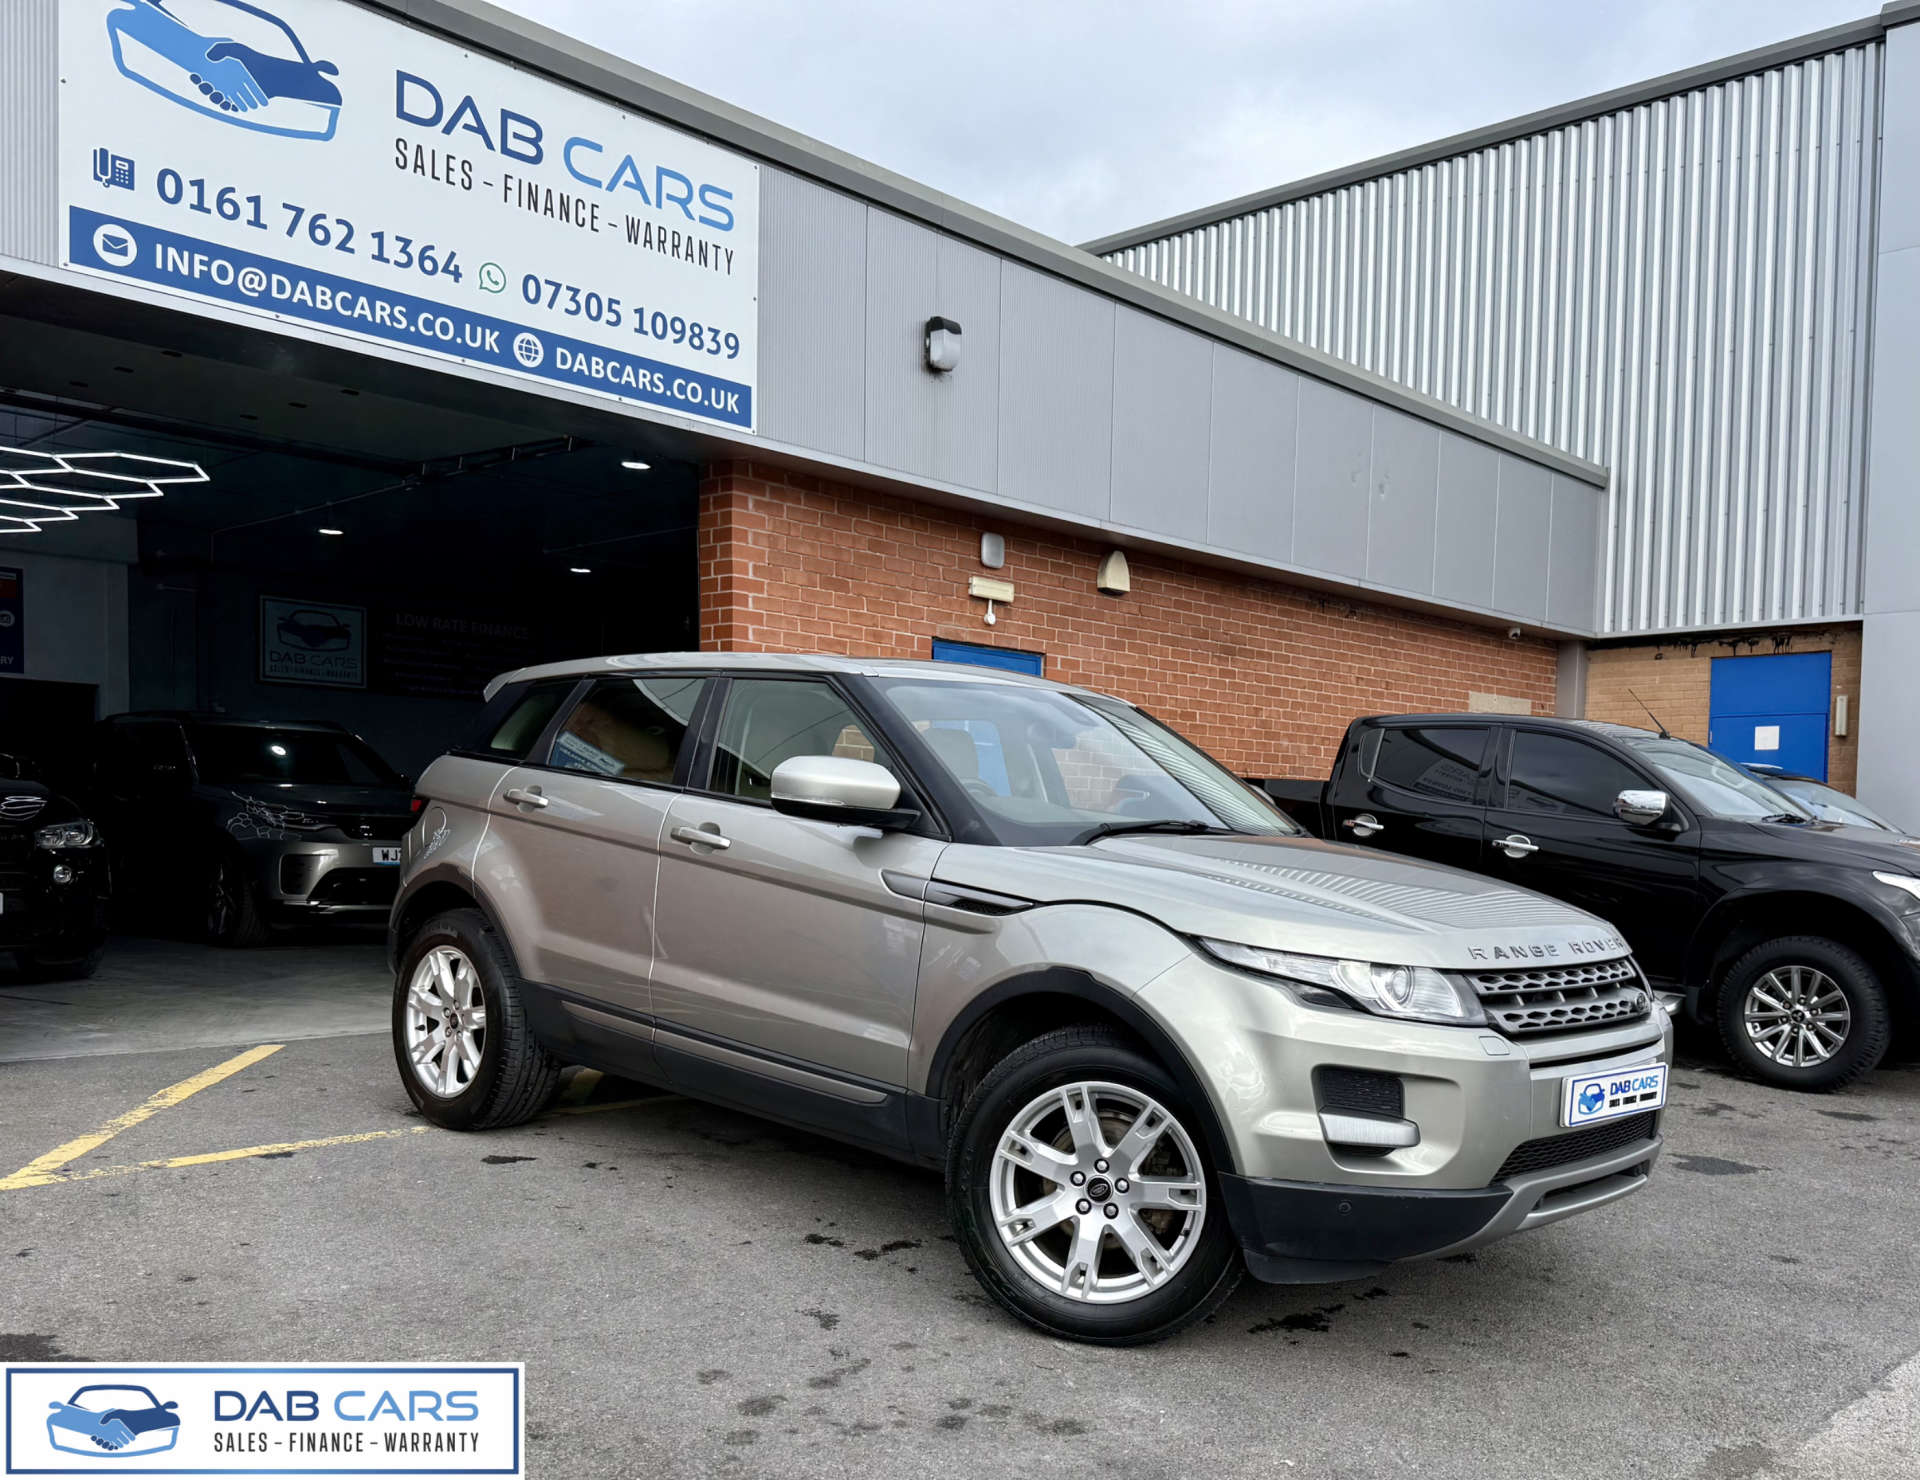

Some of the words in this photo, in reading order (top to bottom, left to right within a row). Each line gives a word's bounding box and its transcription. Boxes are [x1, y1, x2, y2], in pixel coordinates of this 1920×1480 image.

[396, 69, 544, 165] DAB
[563, 136, 735, 232] CARS
[156, 168, 268, 230] 0161
[281, 202, 355, 254] 762
[371, 231, 463, 283] 1364
[395, 137, 473, 190] SALES
[504, 173, 600, 232] FINANCE
[625, 214, 734, 275] WARRANTY
[155, 243, 501, 353] INFO@DABCARS.CO.UK
[522, 274, 622, 327] 07305
[633, 307, 740, 360] 109839
[556, 347, 740, 414] DABCARS.CO.UK
[269, 650, 306, 664] DAB
[381, 848, 402, 861] WJ
[1467, 943, 1560, 960] RANGE
[1567, 937, 1625, 954] ROVER
[1610, 1080, 1631, 1095] DAB
[1632, 1075, 1658, 1091] CARS
